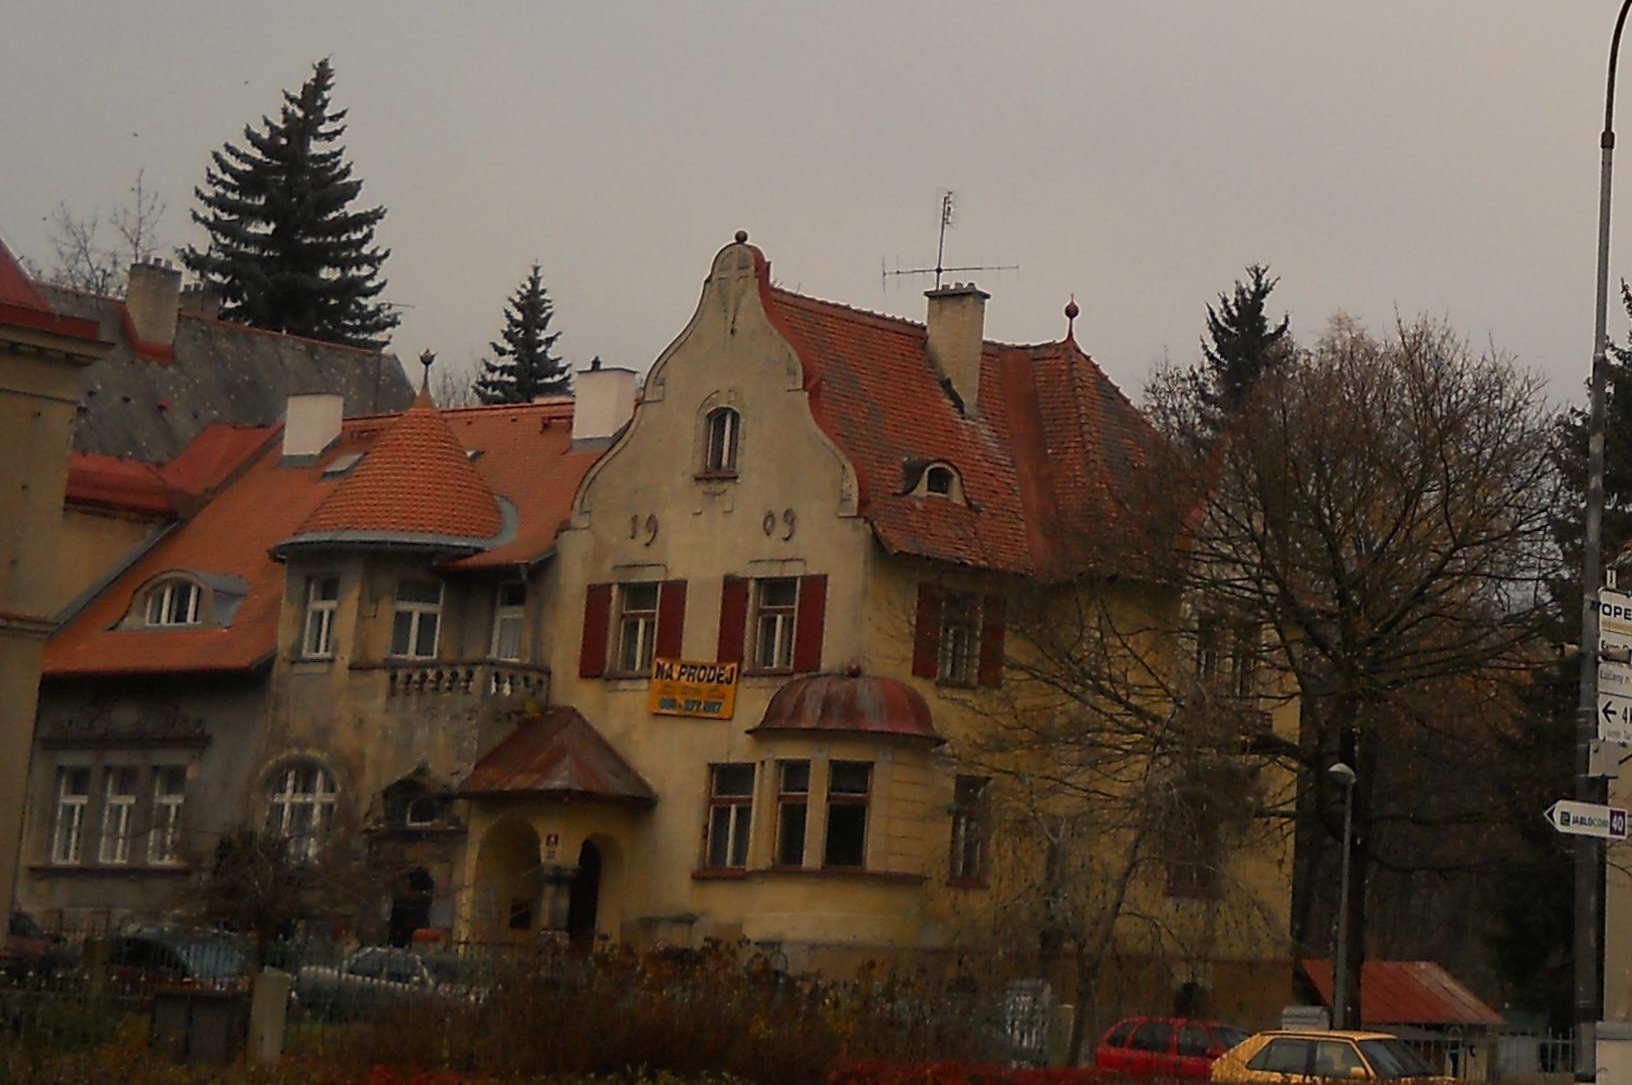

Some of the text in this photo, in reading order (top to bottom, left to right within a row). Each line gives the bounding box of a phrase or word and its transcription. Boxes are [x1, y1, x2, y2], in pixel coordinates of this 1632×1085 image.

[630, 509, 795, 546] 19 09
[655, 662, 734, 685] NA PRODEJ
[1622, 706, 1628, 724] 4
[1612, 815, 1624, 832] 40
